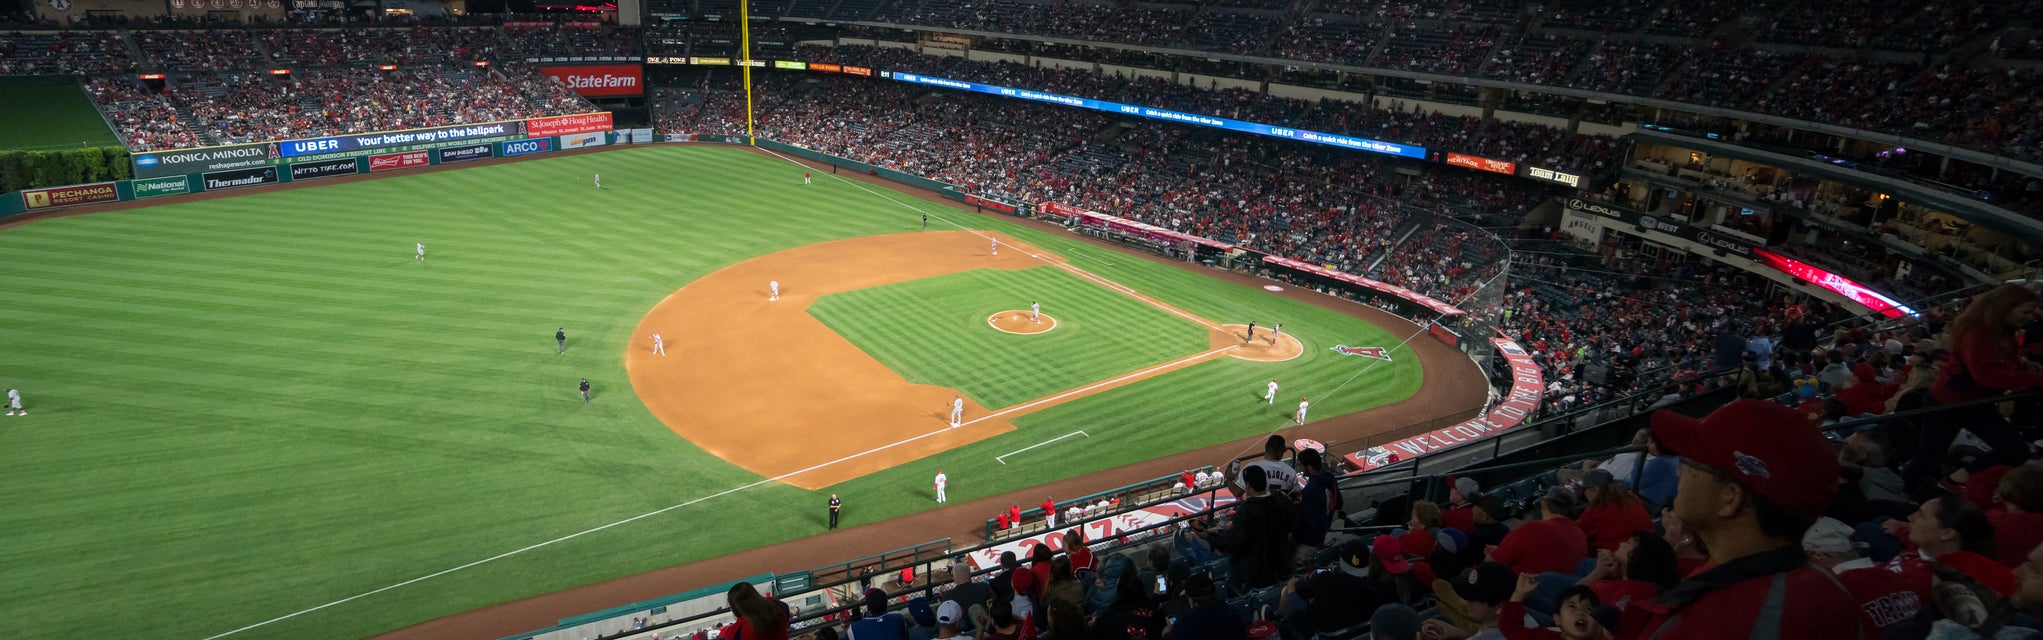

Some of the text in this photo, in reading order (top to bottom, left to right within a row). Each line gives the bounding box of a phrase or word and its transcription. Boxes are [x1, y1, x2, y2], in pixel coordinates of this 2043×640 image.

[1121, 106, 1139, 114] UBER
[357, 125, 504, 147] Your better way to the ballpark
[1271, 127, 1294, 137] UBER
[295, 139, 339, 152] UBER
[412, 142, 436, 150] HELPING
[447, 139, 467, 147] WORLD
[481, 136, 506, 144] PROMISES
[507, 142, 538, 153] ARCO
[1303, 132, 1318, 141] Catch
[1322, 135, 1336, 144] quick
[1337, 137, 1348, 145] ride
[1349, 139, 1362, 147] from
[1362, 141, 1371, 149] the
[1372, 143, 1386, 151] Uber
[1386, 145, 1401, 153] Zone
[162, 148, 263, 164] KONICA MINOLTA
[312, 152, 345, 161] DOMINION
[346, 149, 373, 158] FREIGHT
[209, 159, 266, 170] reshapework.com
[294, 163, 355, 176] NITTO TIRE.COM
[1485, 159, 1511, 168] ORGANIC
[207, 175, 264, 188] Thermador
[1530, 167, 1580, 187] Team Lally
[148, 180, 185, 191] National
[52, 187, 113, 199] PECHANGA
[54, 196, 83, 204] RESORT
[1584, 204, 1621, 218] LEXUS
[1568, 219, 1596, 234] ANGELS
[1657, 221, 1679, 233] WEST
[1709, 237, 1749, 254] LEXUS
[1516, 366, 1540, 385] BIG
[1509, 385, 1540, 406] THE
[1494, 403, 1528, 421] TO
[1393, 416, 1503, 455] WELCOME
